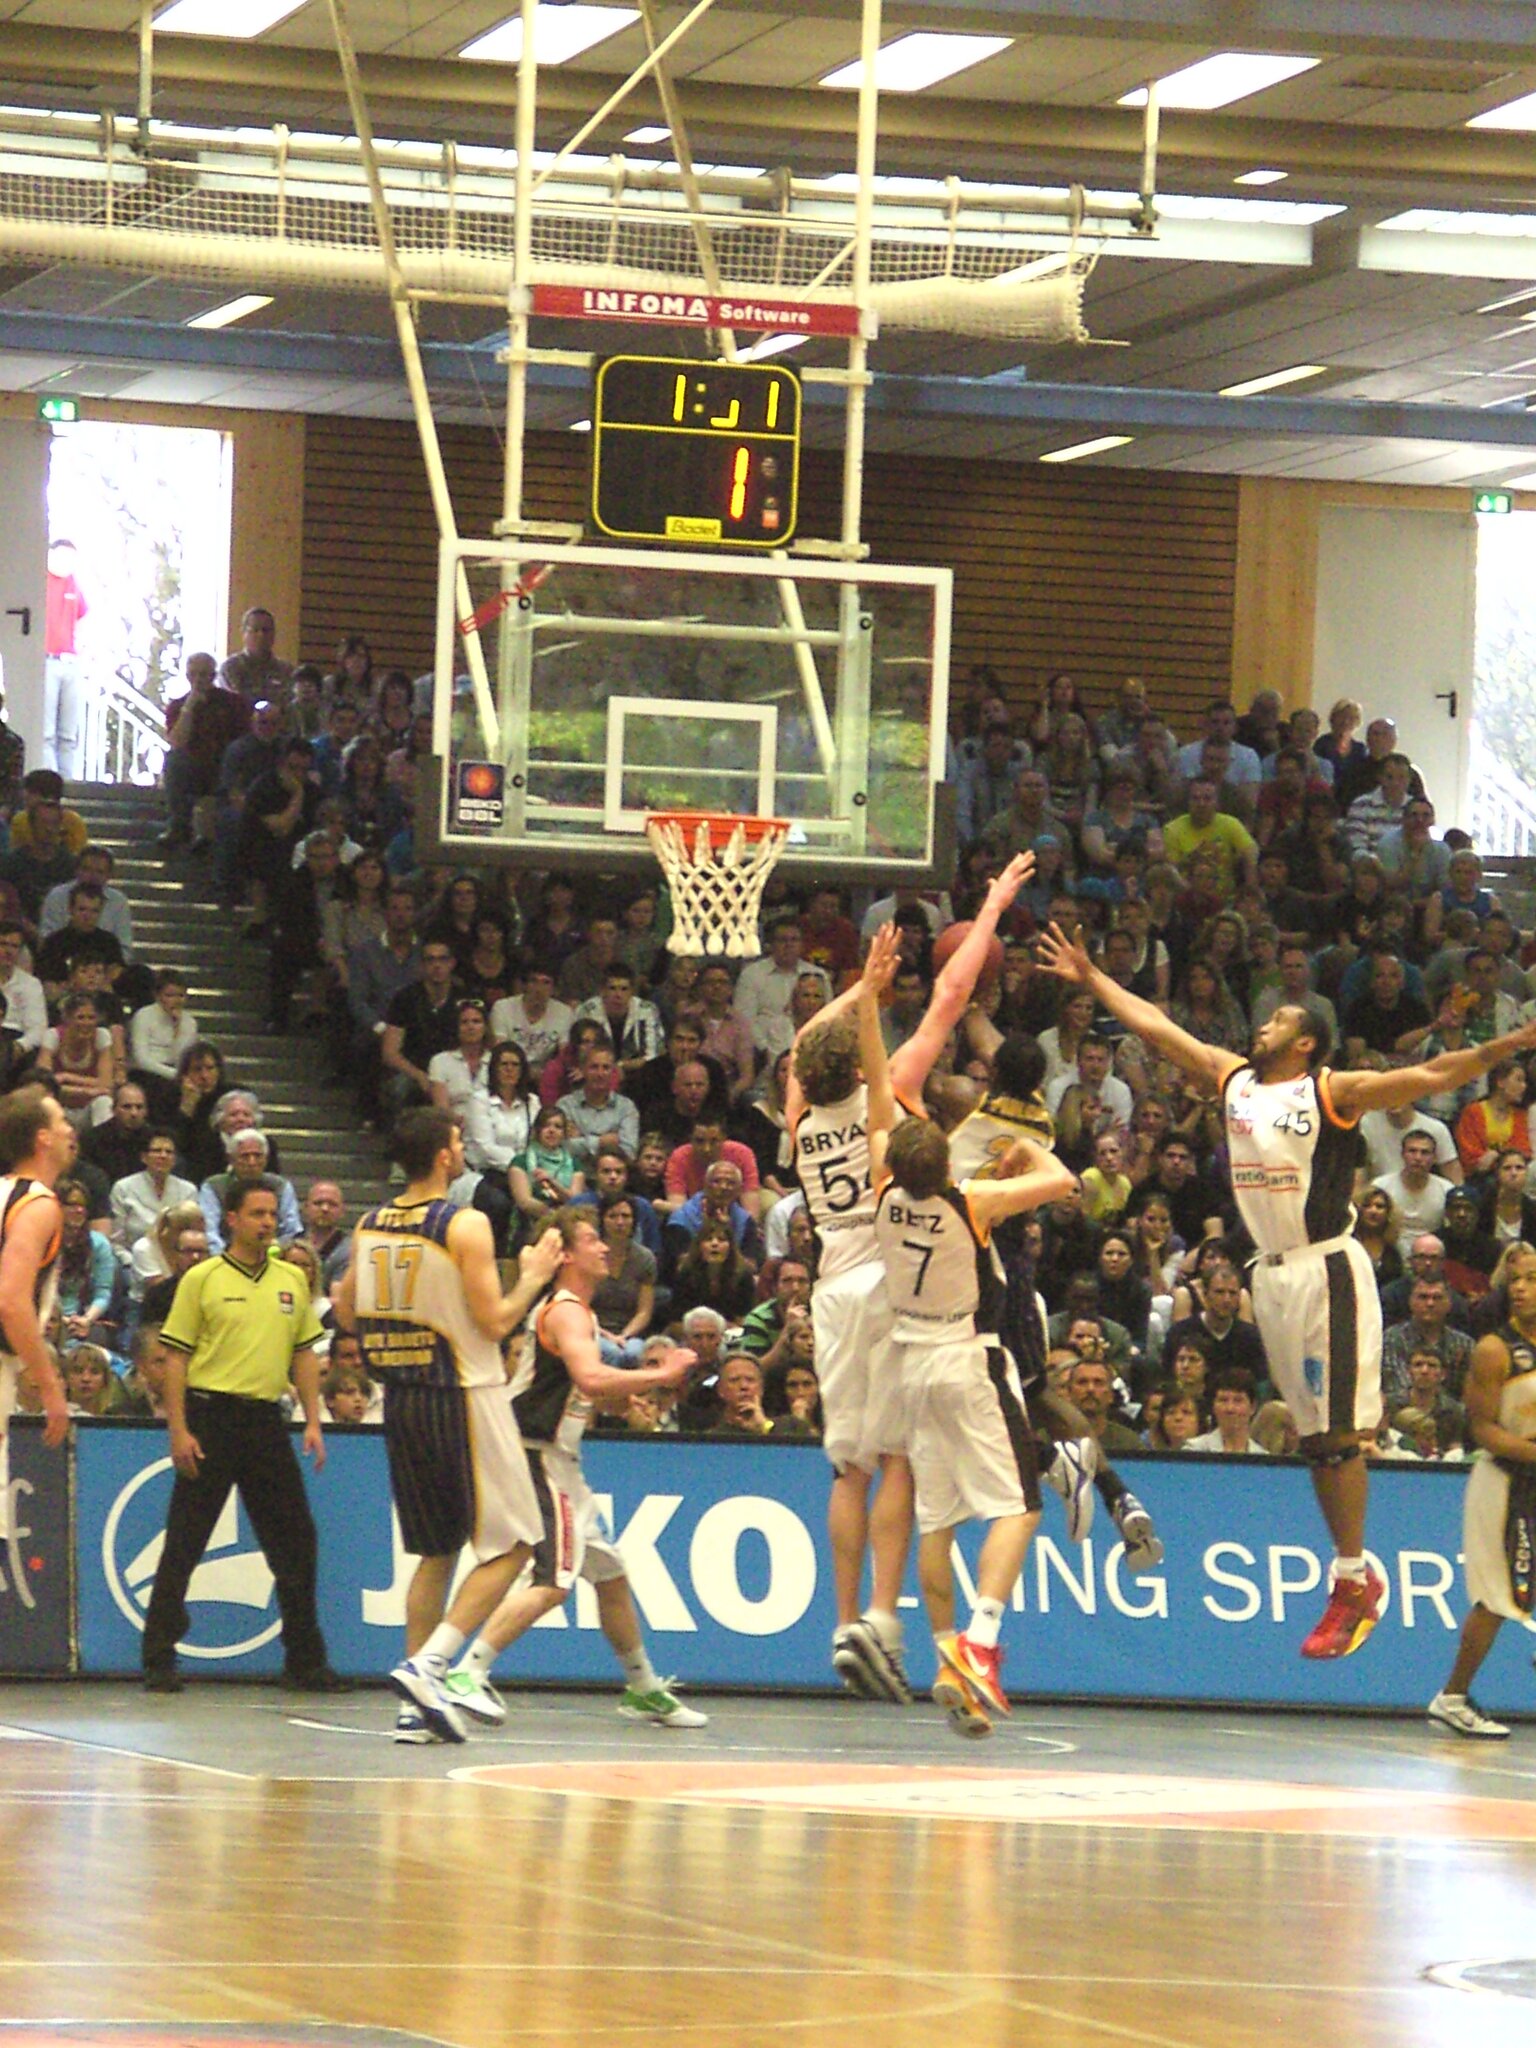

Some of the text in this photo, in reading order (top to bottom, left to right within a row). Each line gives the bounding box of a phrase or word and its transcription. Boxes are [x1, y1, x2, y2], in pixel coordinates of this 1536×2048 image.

[583, 289, 811, 325] INFOMA Software
[800, 1124, 869, 1155] BRYA
[1273, 1109, 1312, 1136] 45
[818, 1157, 870, 1212] 5
[369, 1244, 424, 1311] 17
[902, 1240, 934, 1296] 7
